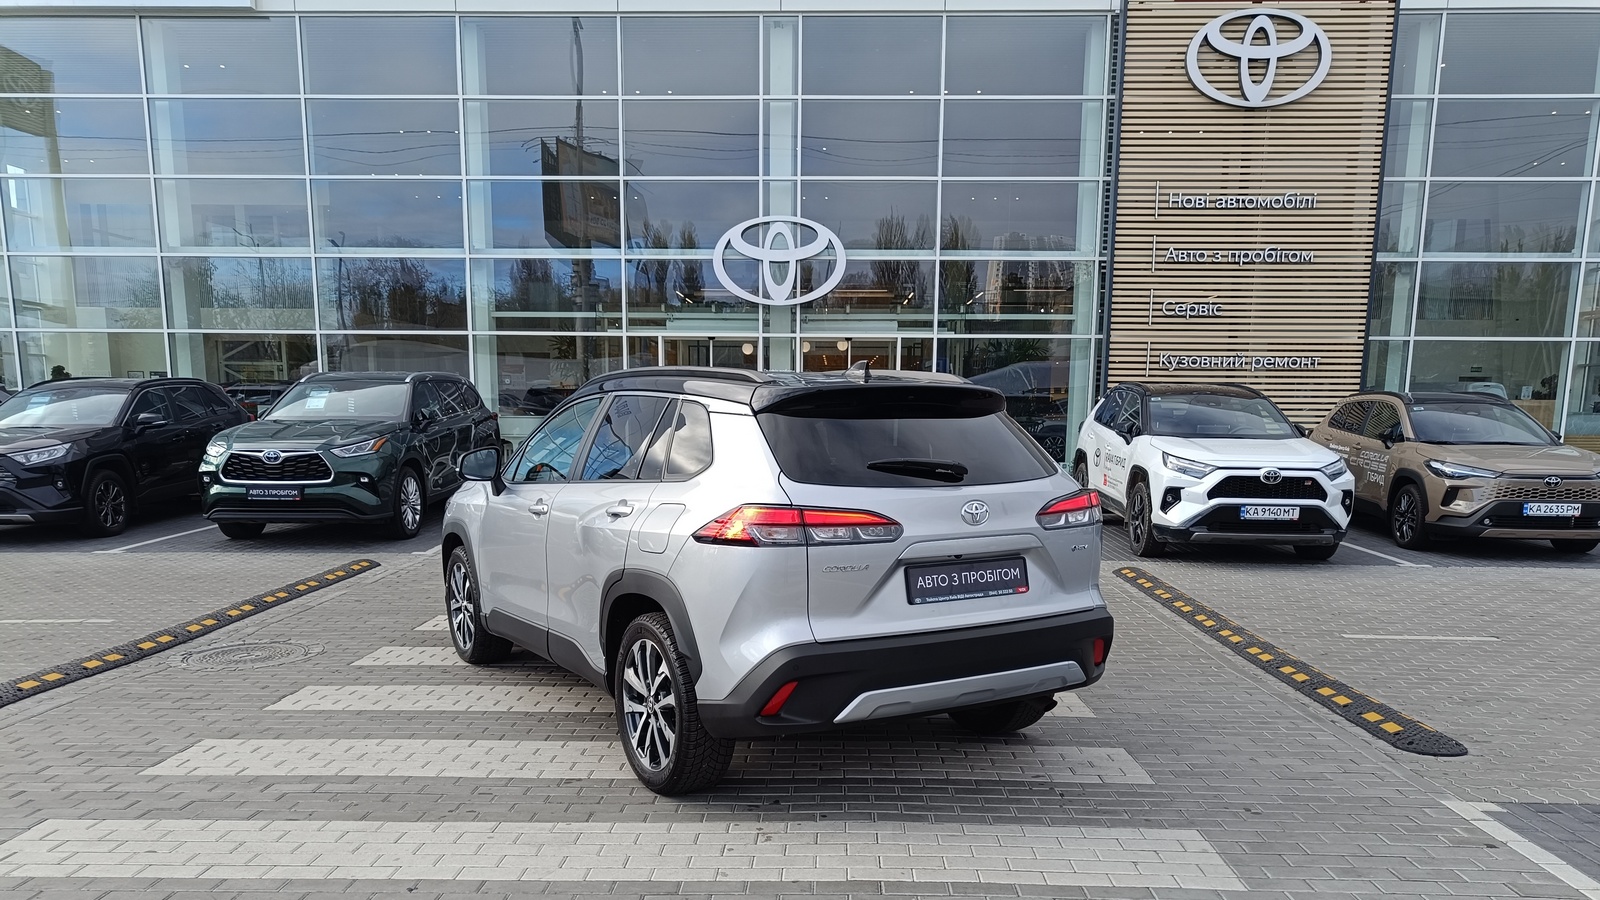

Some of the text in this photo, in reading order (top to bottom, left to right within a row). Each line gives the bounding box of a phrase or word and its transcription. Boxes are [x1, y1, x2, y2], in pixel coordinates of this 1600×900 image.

[1168, 191, 1318, 209] Нові автомобілі
[1164, 246, 1315, 267] Авто з пробігом
[1162, 300, 1223, 320] Сервіс
[1158, 352, 1322, 372] Кузовний ремонт
[1349, 456, 1388, 473] CROSS
[1360, 450, 1390, 463] COROLLA
[1245, 507, 1297, 517] KA 9140 MT
[1529, 504, 1580, 514] KA 2635 PM
[822, 563, 870, 573] COROLLA
[917, 567, 1021, 589] АВТО З ПРОБІГОМ
